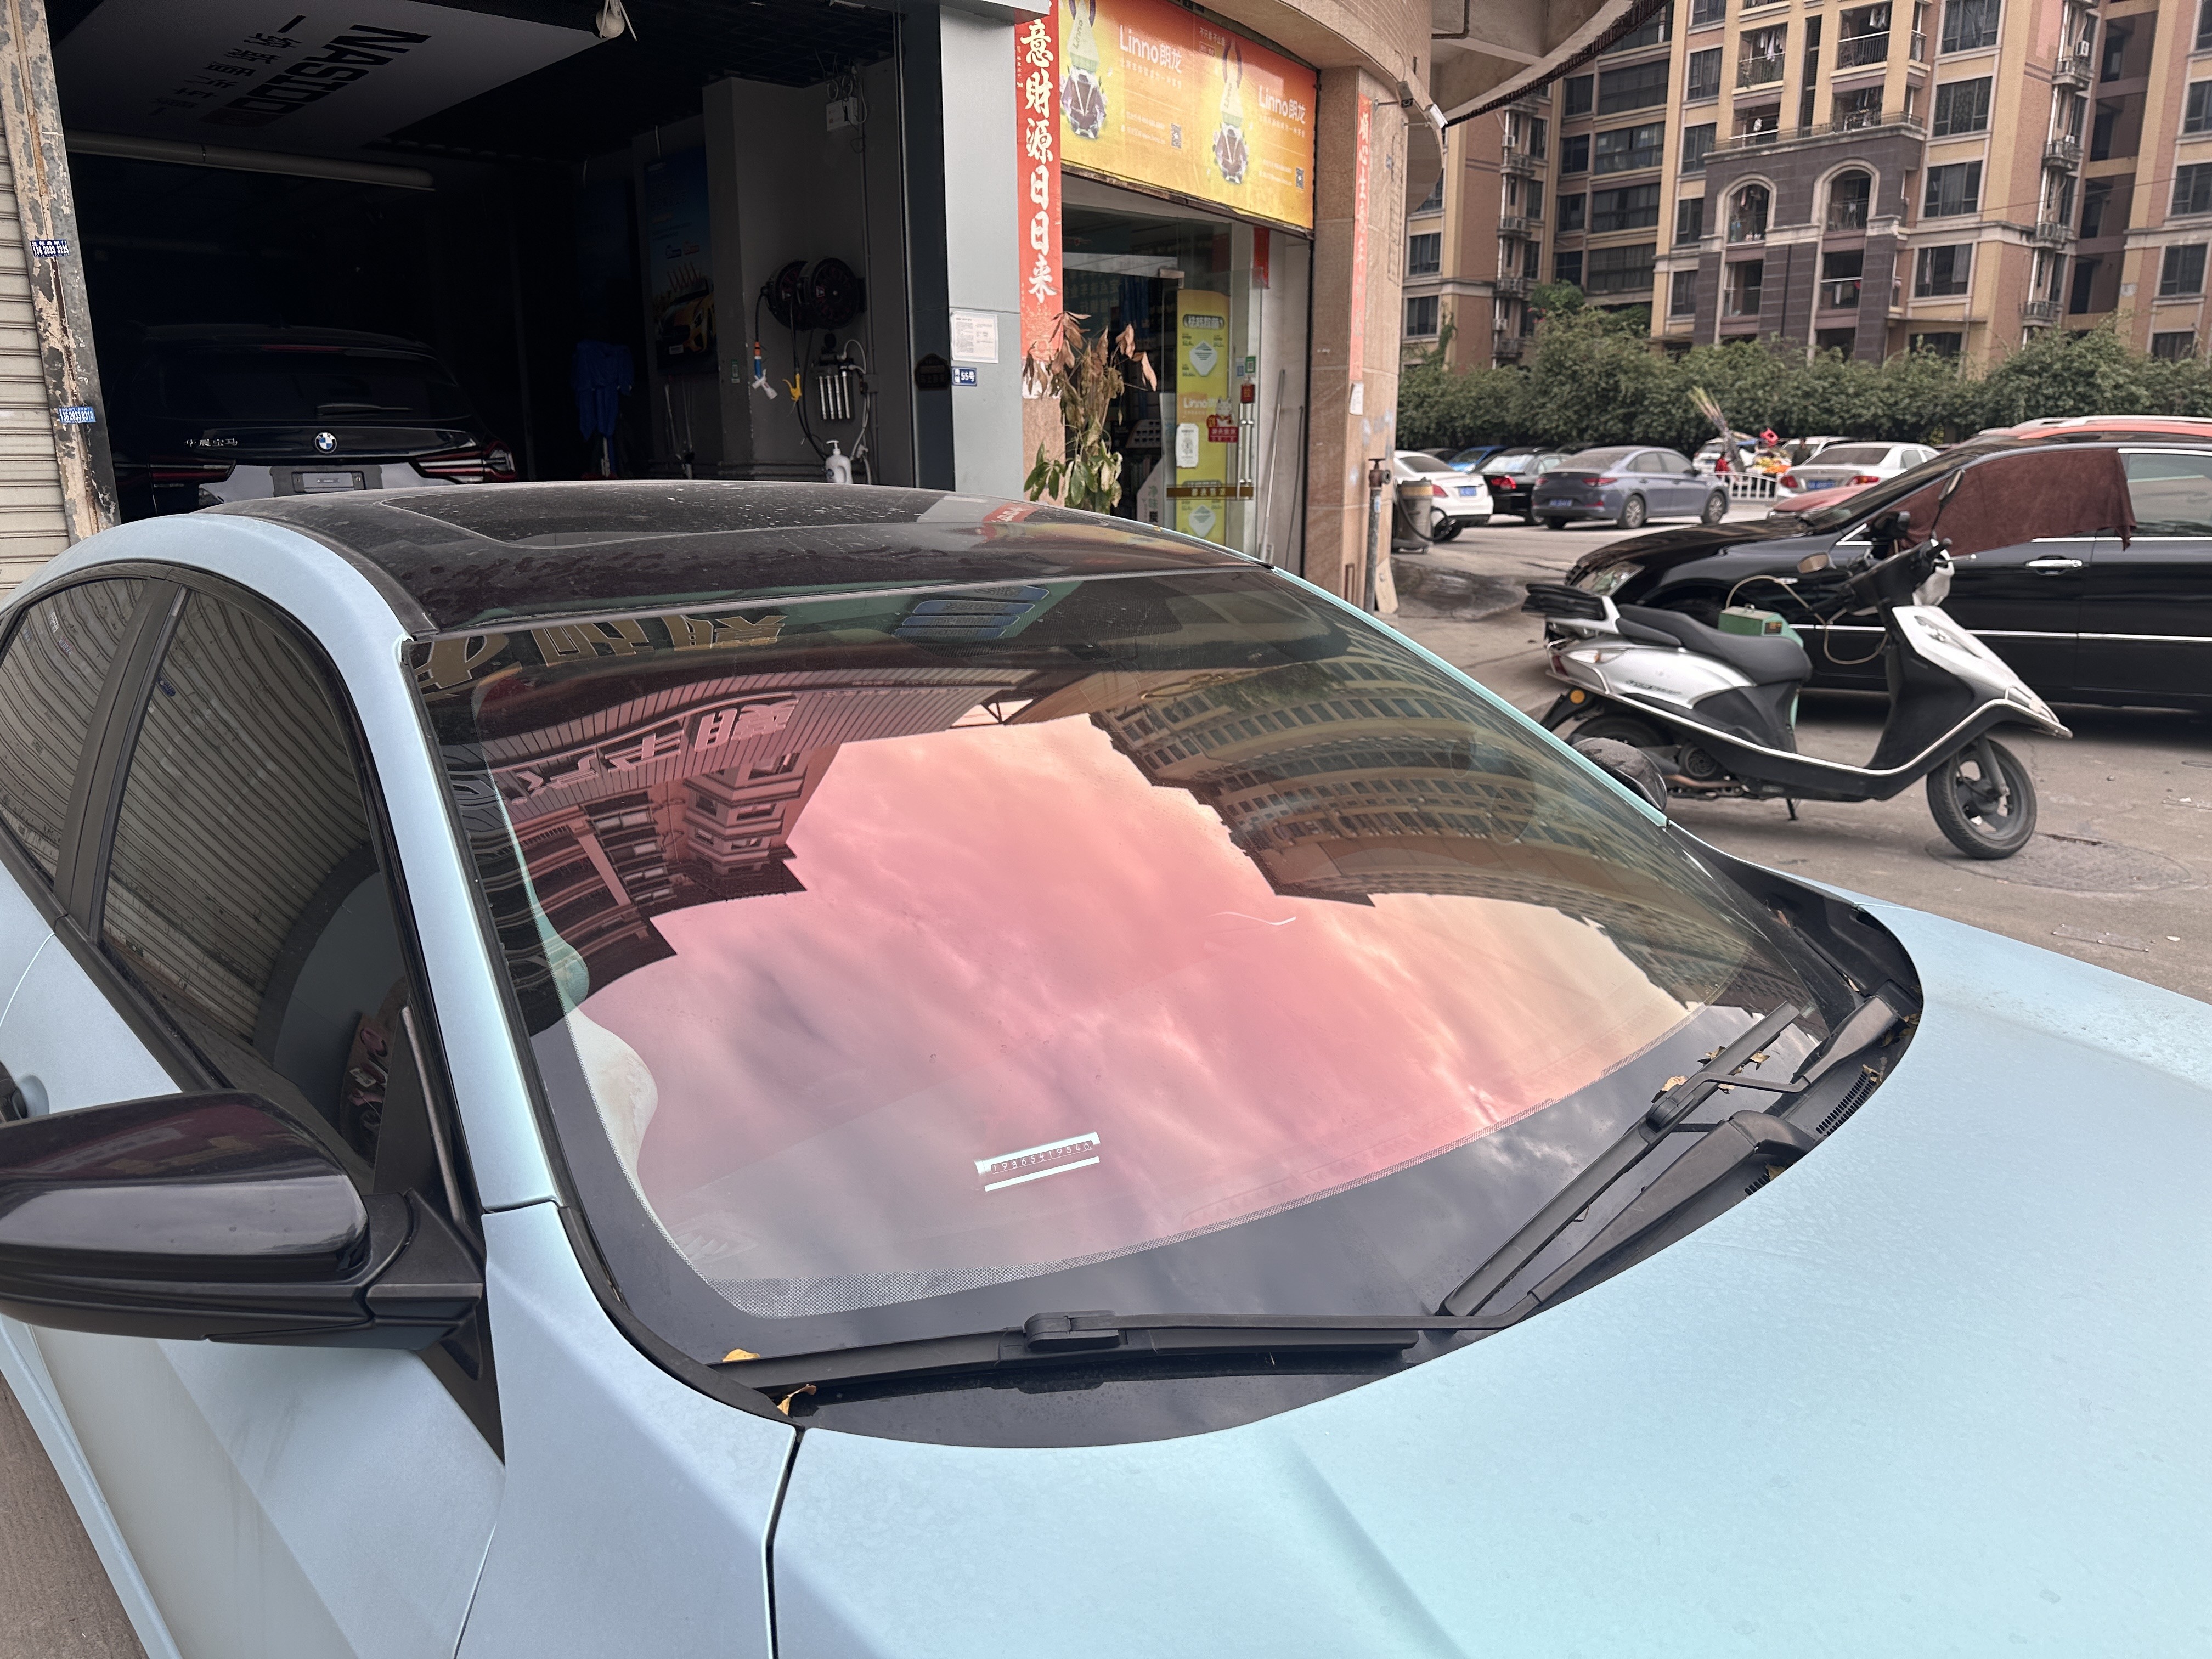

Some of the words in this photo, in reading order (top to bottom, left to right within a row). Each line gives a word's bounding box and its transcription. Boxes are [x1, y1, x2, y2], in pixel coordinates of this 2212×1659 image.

[1020, 18, 1057, 303] 意財源日日来
[961, 371, 975, 382] 55号
